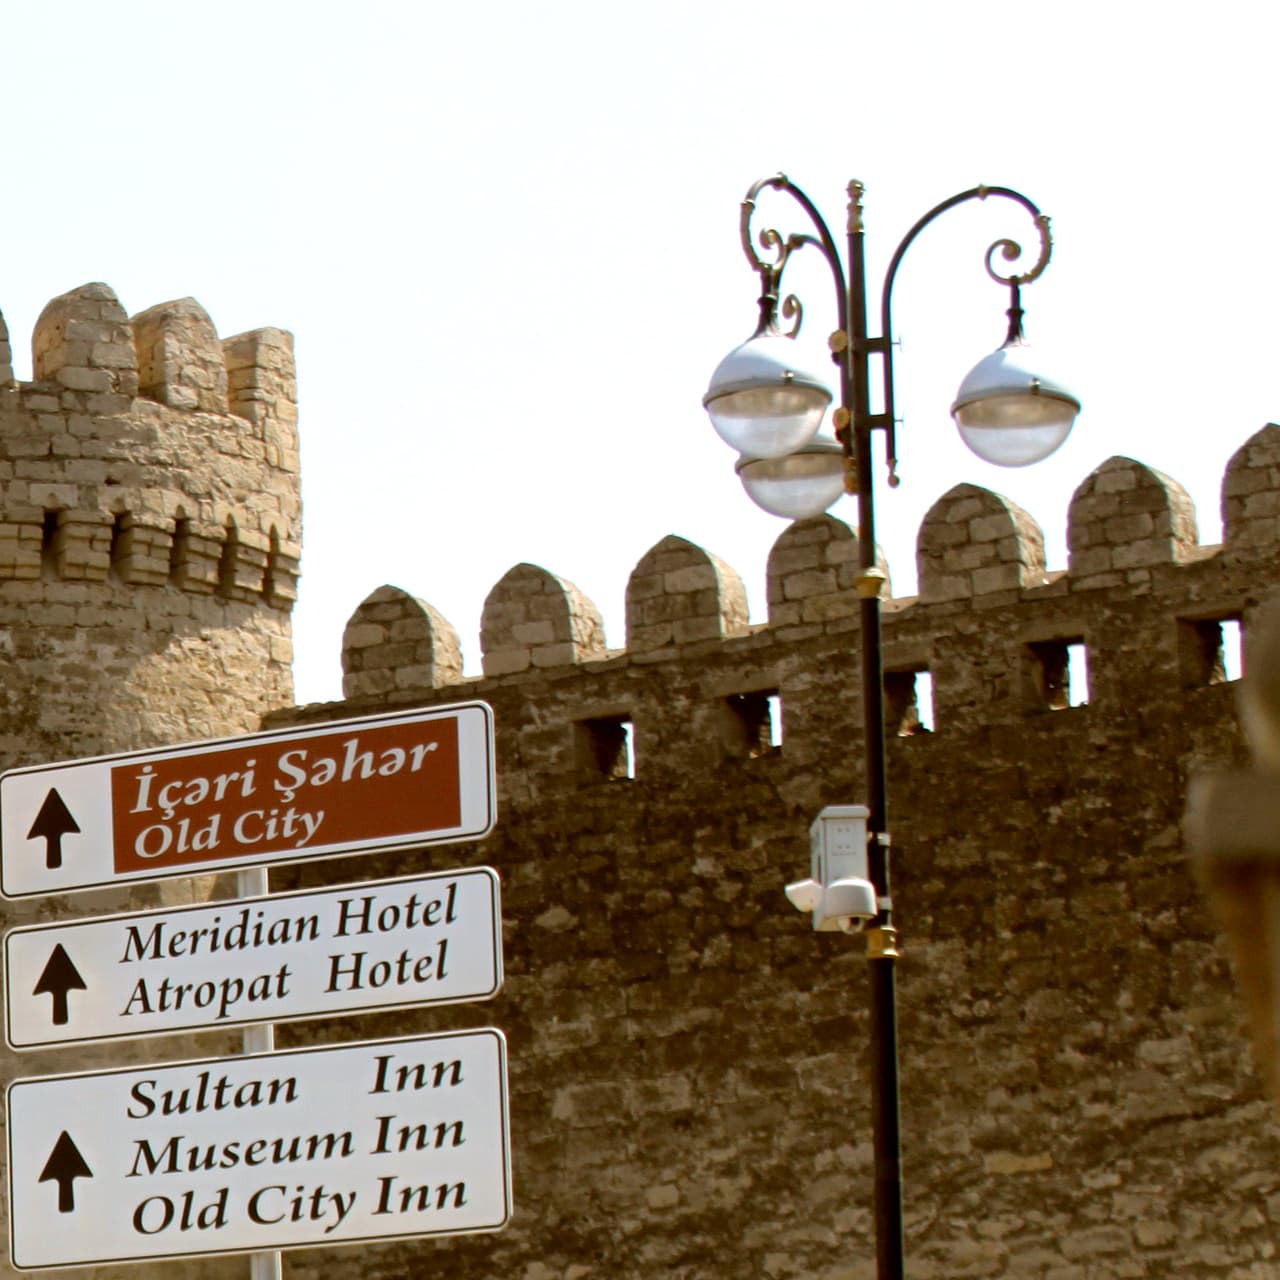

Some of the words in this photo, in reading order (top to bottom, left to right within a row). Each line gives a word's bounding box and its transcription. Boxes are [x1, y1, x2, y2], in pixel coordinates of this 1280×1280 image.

[129, 758, 258, 820] İçəri
[273, 738, 438, 803] Şəhər
[134, 824, 222, 860] Old
[233, 808, 325, 849] City
[118, 908, 320, 964] Meridian
[332, 882, 458, 938] Hotel
[118, 963, 293, 1020] Atropat
[323, 938, 449, 994] Hotel
[127, 1071, 299, 1119] Sultan
[368, 1055, 465, 1094] Inn
[125, 1127, 354, 1178] Museum
[370, 1115, 466, 1154] Inn
[132, 1189, 229, 1235] Old
[247, 1184, 357, 1233] City
[371, 1175, 468, 1215] Inn
